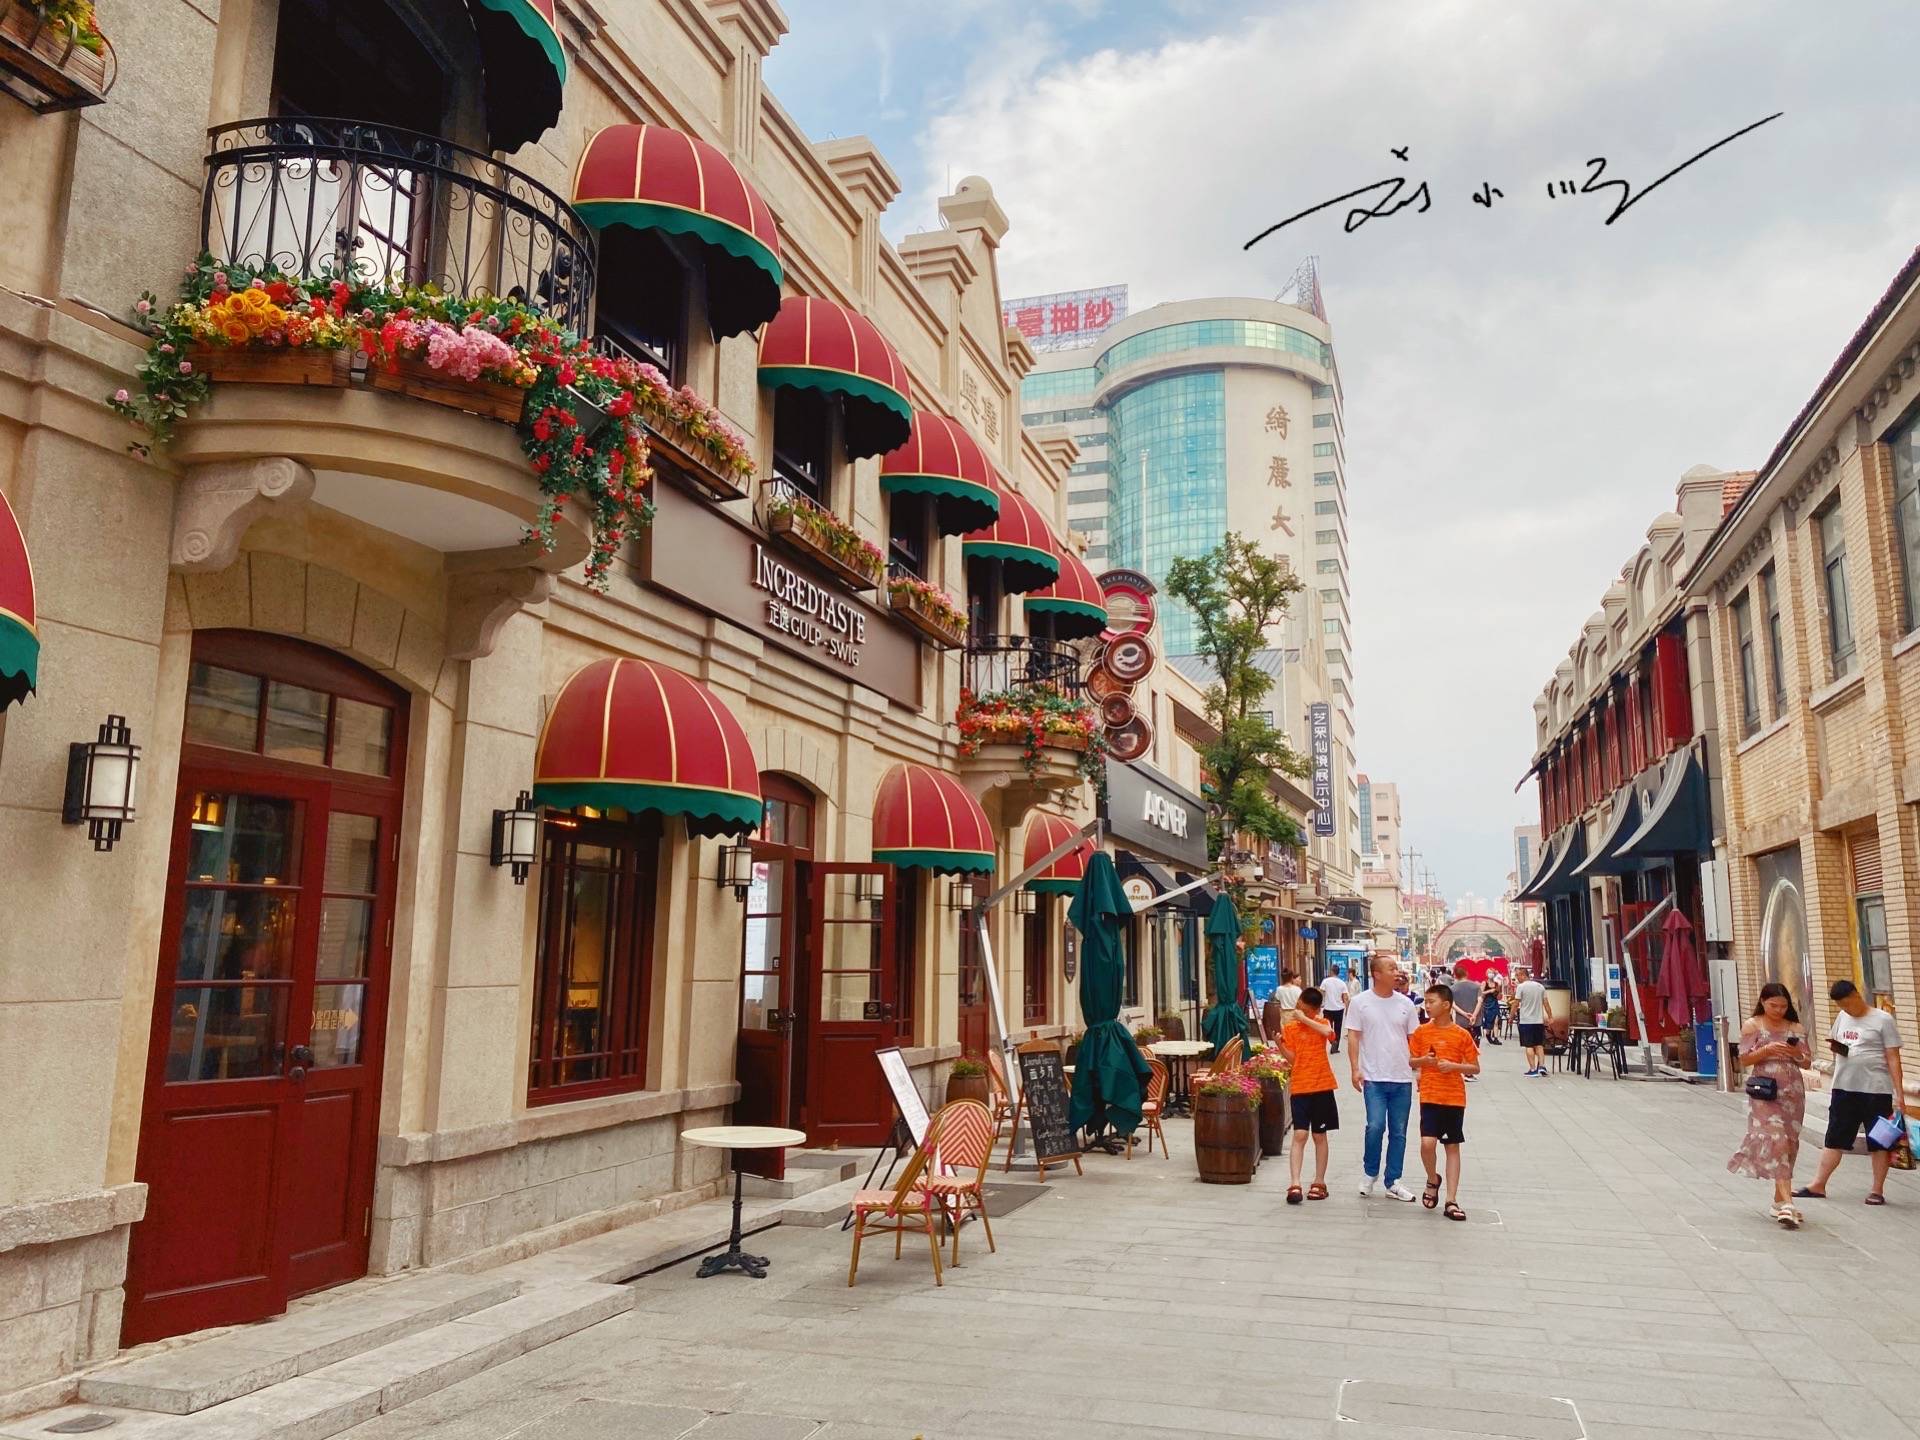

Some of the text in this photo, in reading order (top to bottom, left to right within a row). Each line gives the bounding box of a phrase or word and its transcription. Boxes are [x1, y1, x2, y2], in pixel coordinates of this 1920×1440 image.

[1003, 296, 1114, 337] 臺抽紗
[756, 543, 866, 645] INCREDTASTE
